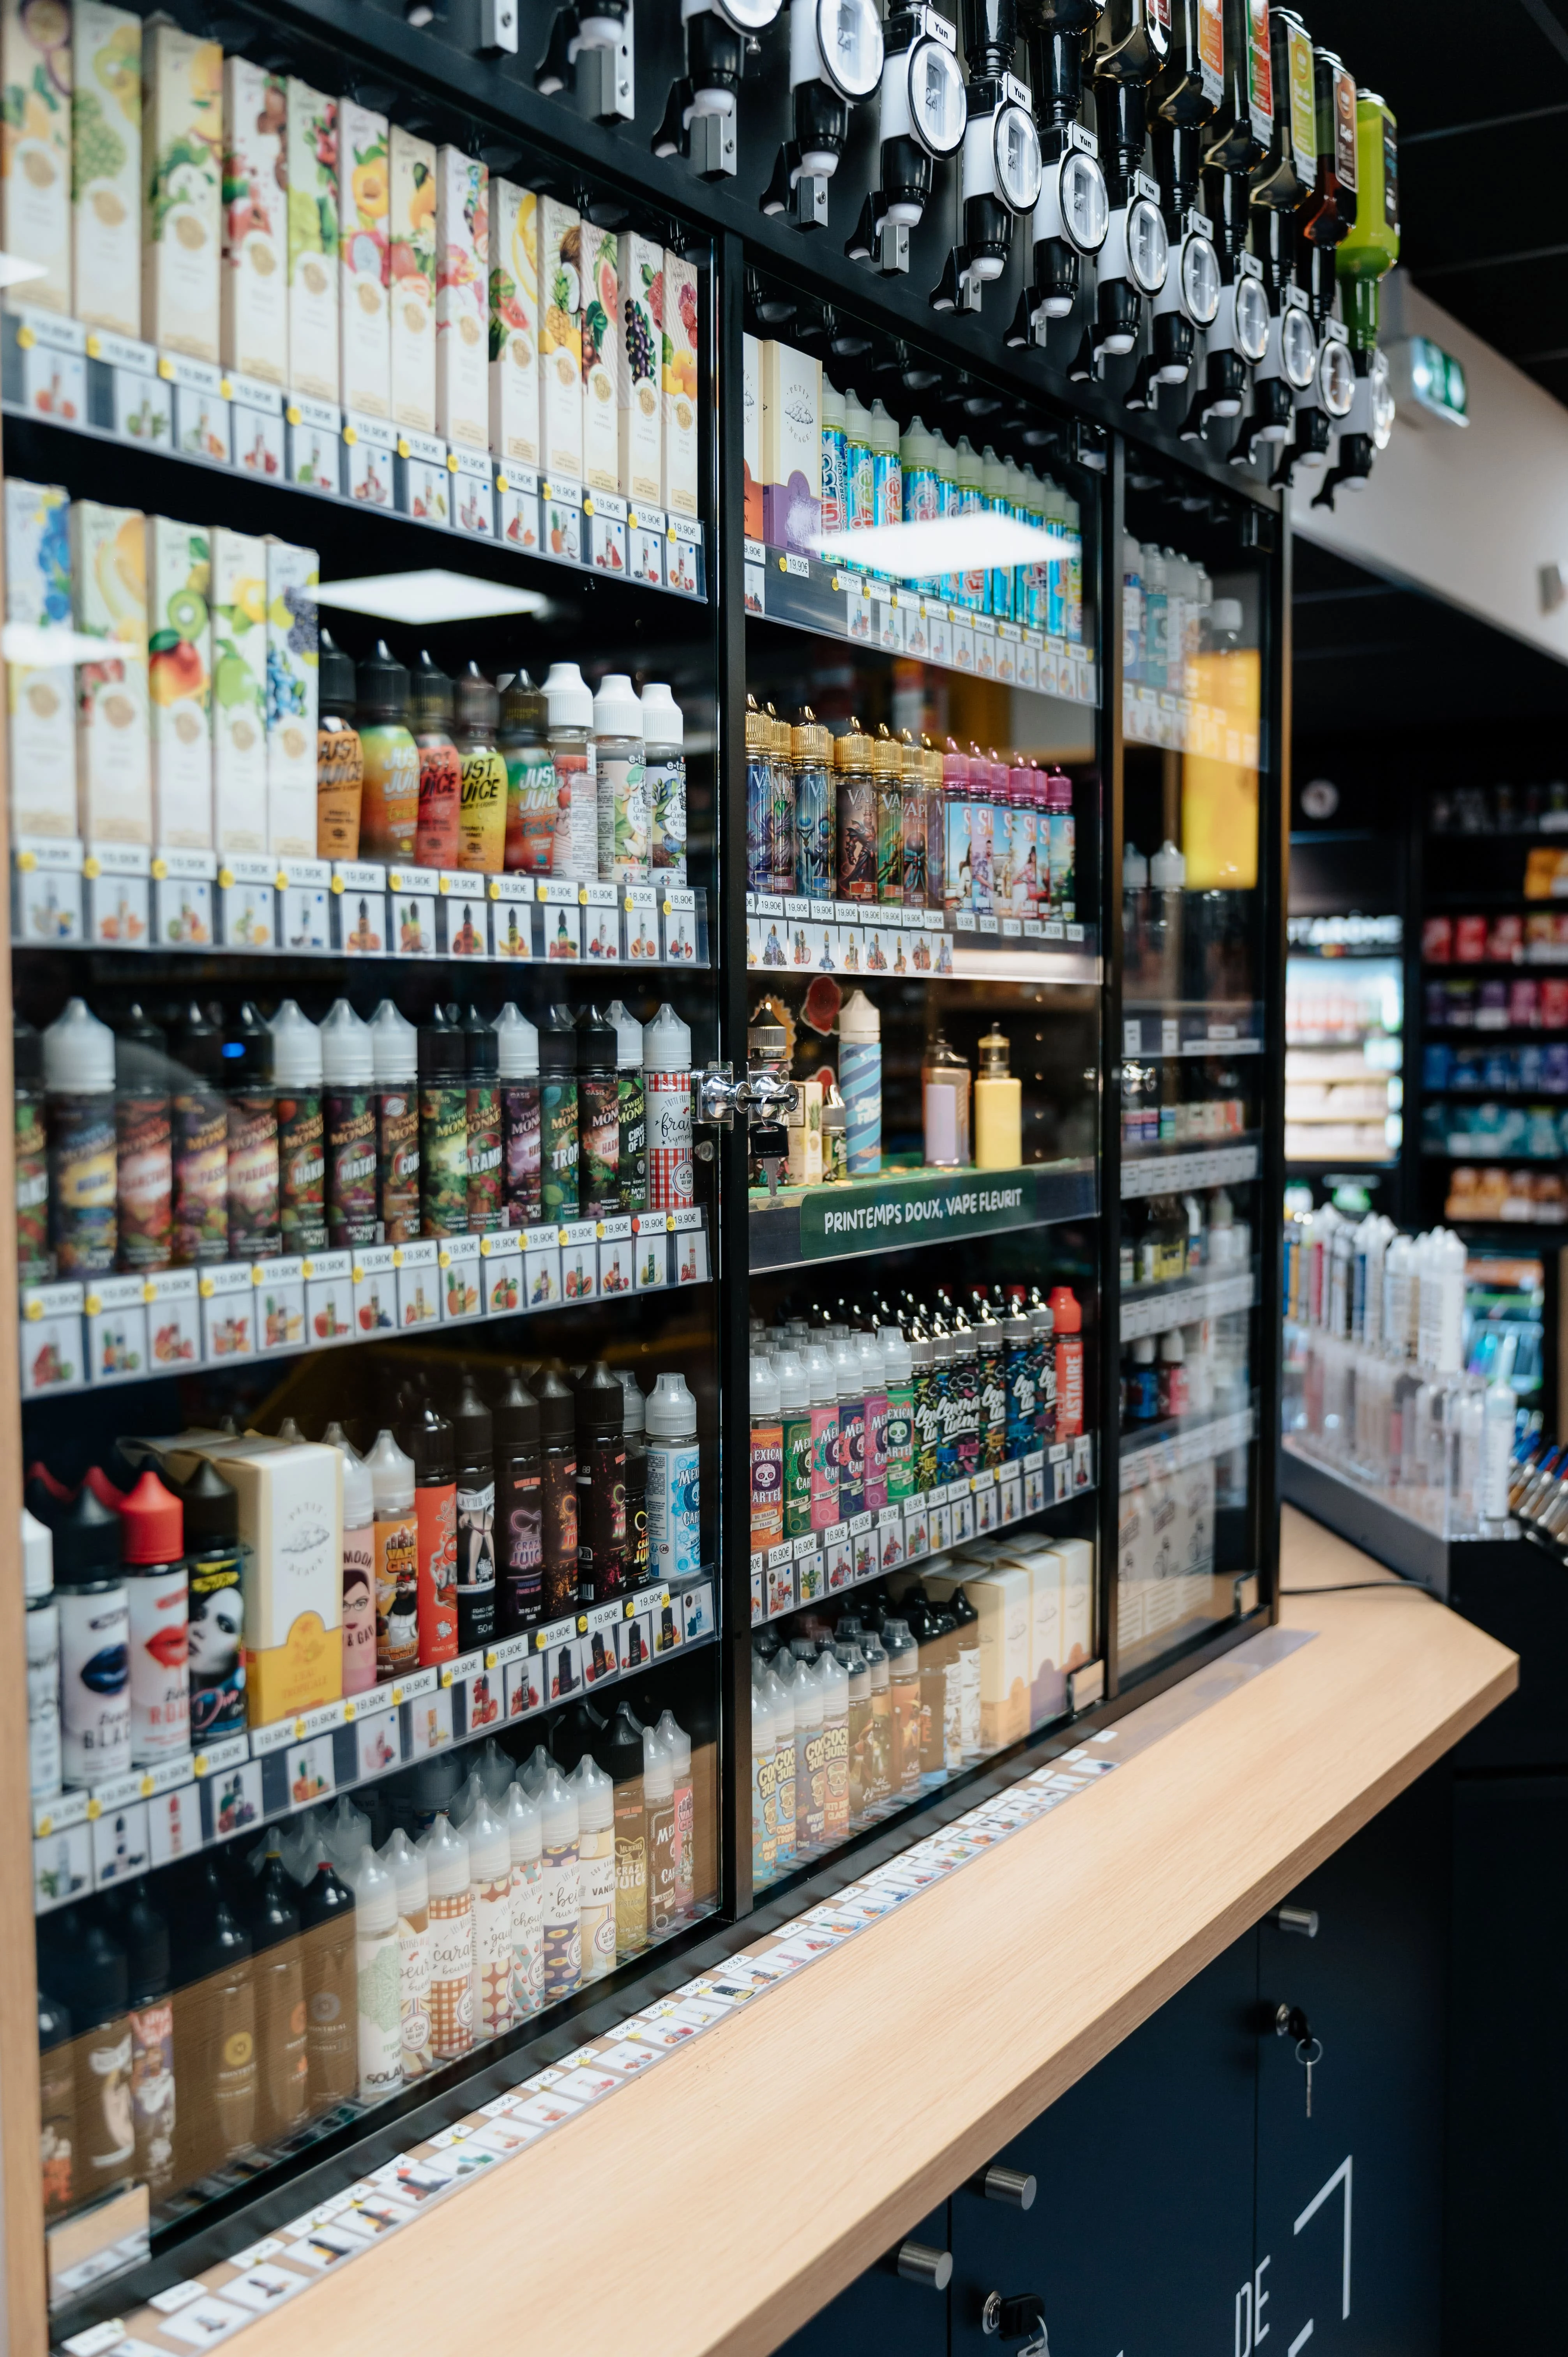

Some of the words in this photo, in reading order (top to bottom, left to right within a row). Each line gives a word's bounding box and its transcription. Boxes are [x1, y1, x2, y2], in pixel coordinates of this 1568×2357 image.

[934, 22, 948, 39] Yun
[1014, 87, 1025, 102] Yun
[1080, 134, 1091, 148] Yun
[1145, 182, 1154, 195] Yun
[789, 385, 809, 400] PETIT
[789, 426, 810, 443] NUAGE
[552, 484, 576, 500] 19,90€
[596, 497, 620, 513] 19,90€
[638, 511, 660, 526] 19,90€
[674, 522, 696, 537] 19,90€
[744, 544, 761, 557] 9,90€
[789, 558, 808, 573] 19,90€
[383, 746, 419, 771] JUS
[461, 758, 495, 780] UST
[461, 778, 500, 802] UiCE
[500, 883, 527, 894] 19,90€
[589, 889, 613, 899] 18,90€
[629, 892, 652, 902] 18,90€
[671, 895, 693, 905] 18,90€
[761, 900, 781, 911] 19,90€
[788, 903, 807, 912] 19,90€
[813, 905, 832, 915] 19,90€
[837, 908, 856, 917] 19,90€
[862, 910, 880, 919] 19,90€
[883, 912, 900, 921] 19,90€
[904, 913, 921, 922] 19,90€
[926, 915, 942, 924] 19,90€
[958, 917, 974, 927] 19,90€
[629, 1140, 639, 1153] OF
[824, 1203, 901, 1235] PRINTEMPS
[904, 1198, 943, 1223] DOUX,
[946, 1193, 977, 1217] VAPE
[979, 1187, 1023, 1212] FLEURIT
[641, 1218, 664, 1229] 19,90€
[675, 1213, 696, 1224] 19,90€
[568, 1228, 592, 1239] 19,90€
[605, 1222, 629, 1233] 19,90€
[491, 1237, 517, 1249] 19,90€
[529, 1232, 554, 1244] 19,90€
[449, 1242, 477, 1254] 19,90€
[1066, 1355, 1082, 1419] ASTAIRE
[750, 1447, 782, 1463] EXICAN
[752, 1491, 782, 1504] ARTEL
[793, 1498, 806, 1506] CACTUS
[906, 1499, 923, 1512] 16,90€
[761, 1510, 776, 1519] DRAGON
[880, 1508, 897, 1522] 16,90€
[852, 1515, 870, 1531] 16,90€
[827, 1526, 845, 1541] 16,90€
[770, 1546, 790, 1562] 16,90€
[795, 1539, 814, 1555] 16,90€
[639, 1591, 662, 1608] 19,90€
[594, 1608, 618, 1624] 19,90€
[546, 1624, 571, 1641] 19,90€
[348, 1635, 354, 1647] &
[496, 1642, 523, 1659] 19,90€
[449, 1659, 477, 1675] 19,90€
[402, 1676, 431, 1694] 19,90€
[356, 1692, 387, 1711] 19,90€
[306, 1709, 339, 1729] 19,90€
[616, 1862, 644, 1876] CRAZY
[618, 1898, 643, 1907] PISTACHE
[719, 1954, 747, 1972] 19,90€
[682, 1977, 708, 1996] 19,90€
[645, 1999, 673, 2019] 19,90€
[612, 2020, 639, 2038] 19,90€
